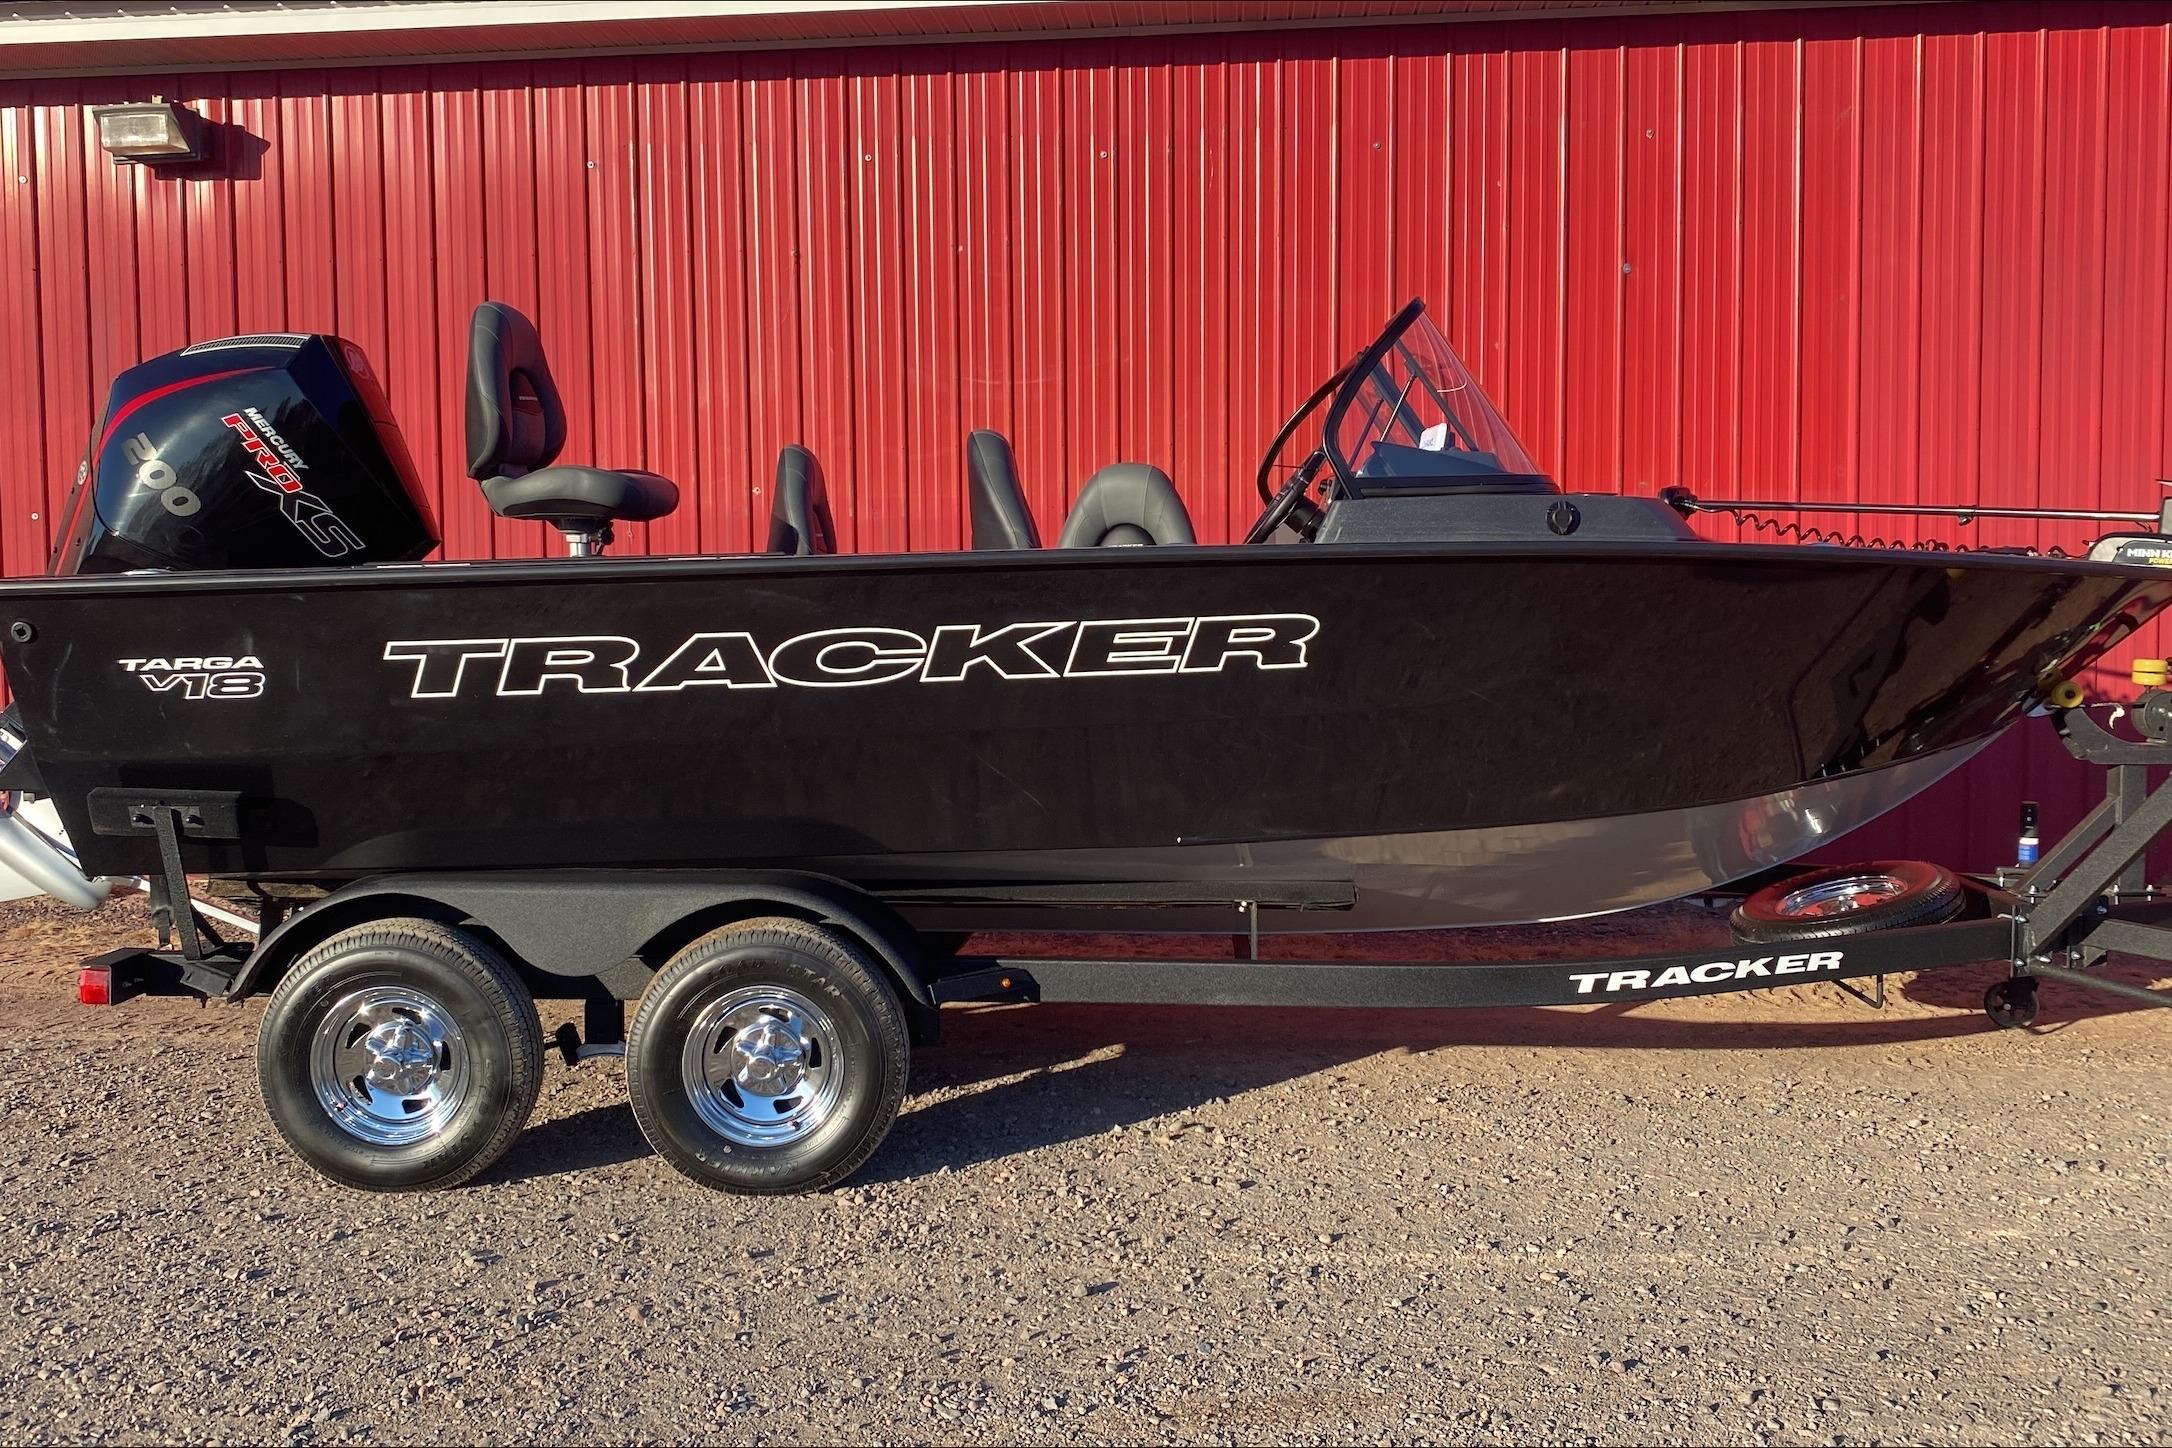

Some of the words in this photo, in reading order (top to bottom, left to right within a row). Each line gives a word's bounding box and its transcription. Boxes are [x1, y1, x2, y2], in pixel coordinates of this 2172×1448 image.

[220, 412, 303, 494] PRO
[243, 406, 309, 470] MERCURY
[121, 431, 201, 517] 200
[242, 469, 366, 557] XS
[2127, 548, 2160, 558] MINN
[118, 656, 265, 671] TARGA
[139, 671, 266, 700] V18
[383, 613, 1320, 698] TRACKER
[1569, 951, 1843, 993] TRACKER
